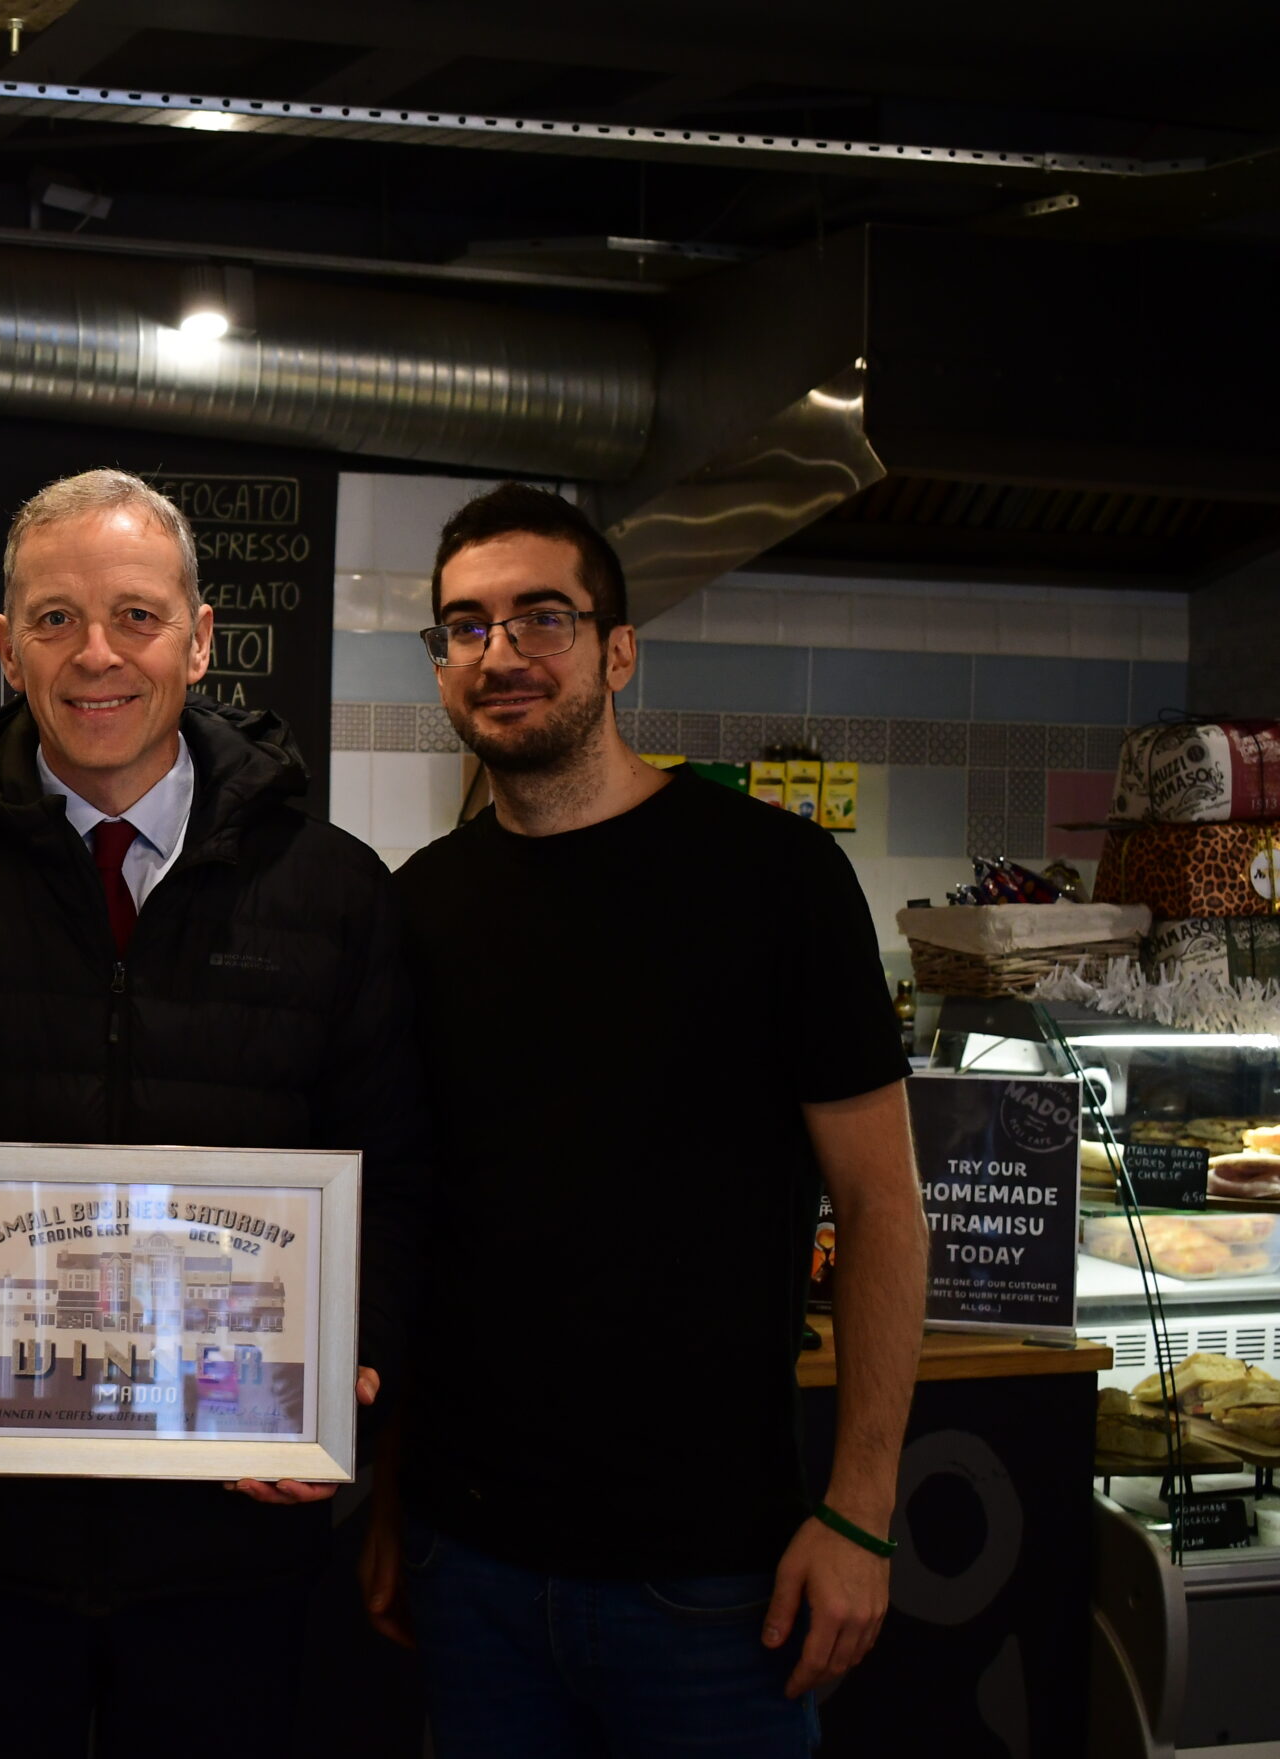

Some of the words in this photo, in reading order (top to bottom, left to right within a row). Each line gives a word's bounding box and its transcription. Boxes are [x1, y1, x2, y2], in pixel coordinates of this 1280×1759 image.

[195, 531, 310, 563] SPRESSO
[1149, 918, 1212, 957] OMMASO
[947, 1159, 983, 1176] TRY
[987, 1160, 1027, 1178] OUR
[1126, 1157, 1166, 1170] CURED
[1172, 1159, 1204, 1170] MEAT
[1137, 1170, 1182, 1182] CHEESE
[920, 1181, 1058, 1207] HOMEMADE
[184, 1203, 296, 1250] SATURDAY
[927, 1212, 1045, 1237] TIRAMISU
[28, 1225, 93, 1248] READING
[96, 1222, 130, 1239] EAST
[188, 1228, 220, 1246] DEC.
[945, 1244, 1026, 1266] TODAY
[933, 1277, 950, 1287] ARE
[952, 1278, 972, 1287] ONE
[973, 1279, 985, 1287] OF
[987, 1280, 1007, 1289] OUR
[1008, 1281, 1058, 1291] CUSTOMER
[955, 1290, 967, 1299] SO
[968, 1292, 999, 1301] HURRY
[1000, 1293, 1035, 1302] BEFORE
[1037, 1294, 1061, 1304] THEY
[960, 1303, 977, 1312] ALL
[96, 1385, 179, 1404] MADOO
[38, 1409, 53, 1420] IN
